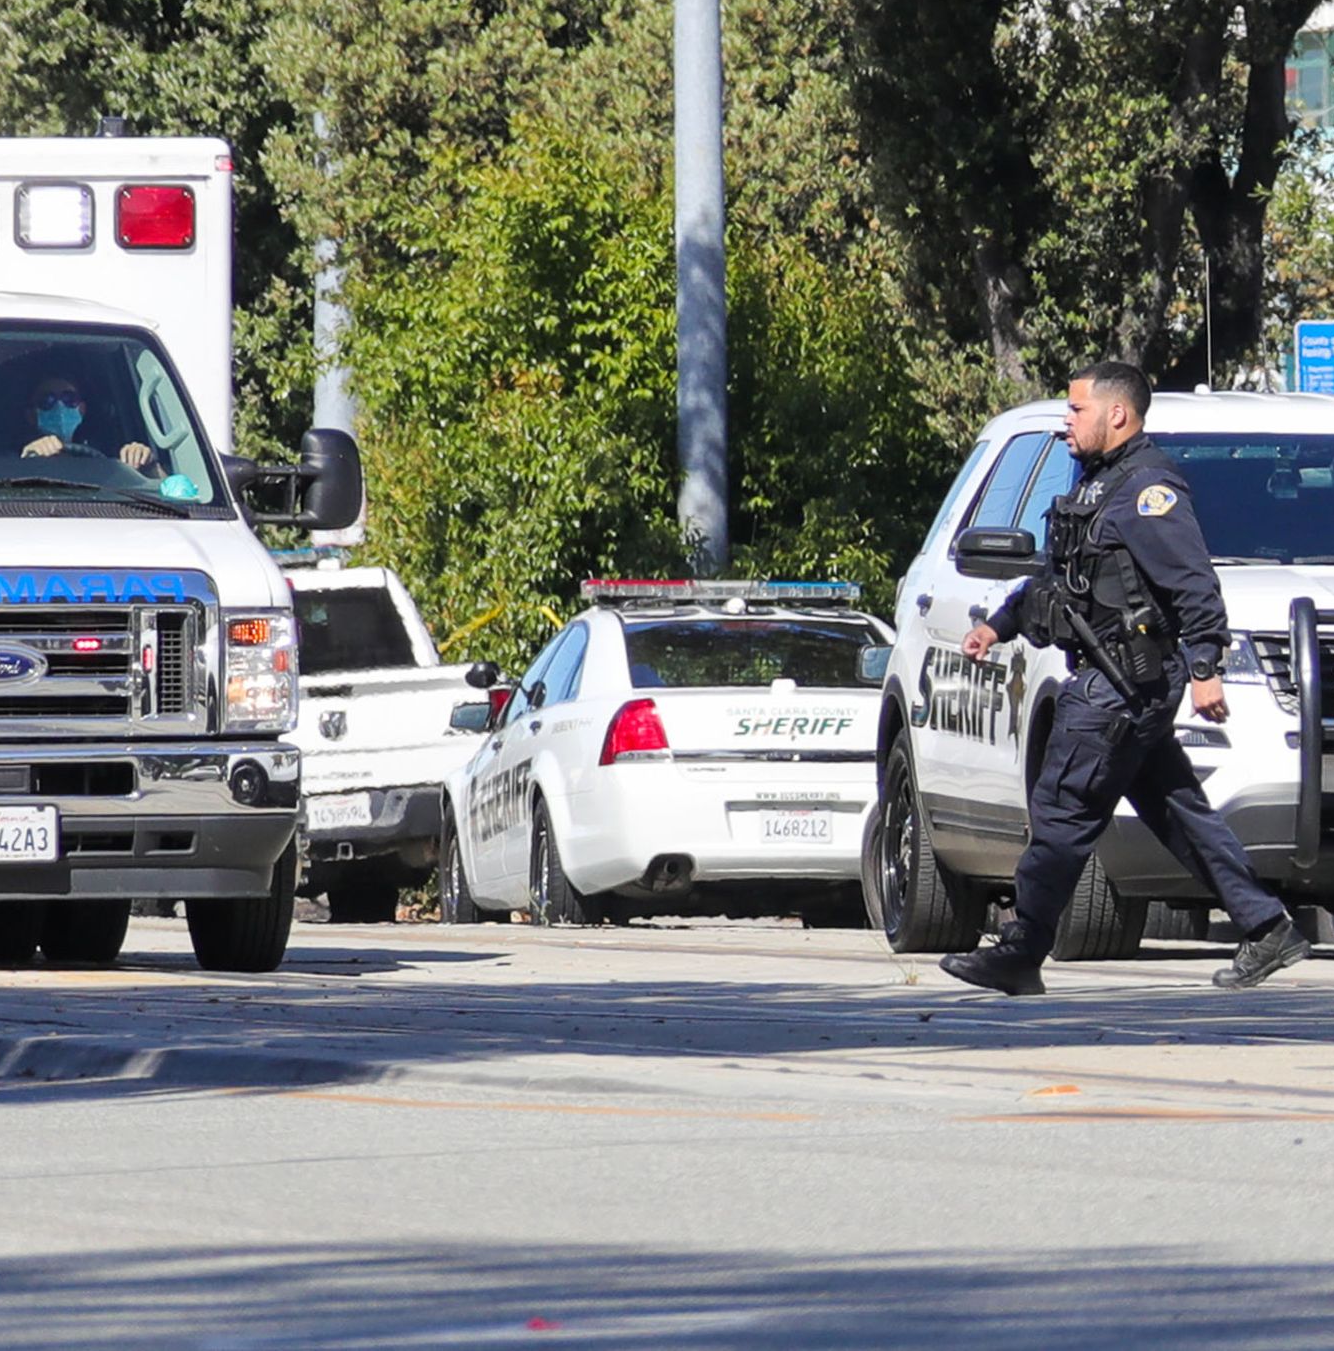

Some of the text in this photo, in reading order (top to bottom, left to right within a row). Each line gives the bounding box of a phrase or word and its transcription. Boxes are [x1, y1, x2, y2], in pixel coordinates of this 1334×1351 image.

[910, 646, 1008, 746] SHERIFF
[726, 706, 859, 717] SANTA CLARA COUNTY
[734, 717, 854, 737] SHERIFF
[765, 819, 828, 838] 1468212
